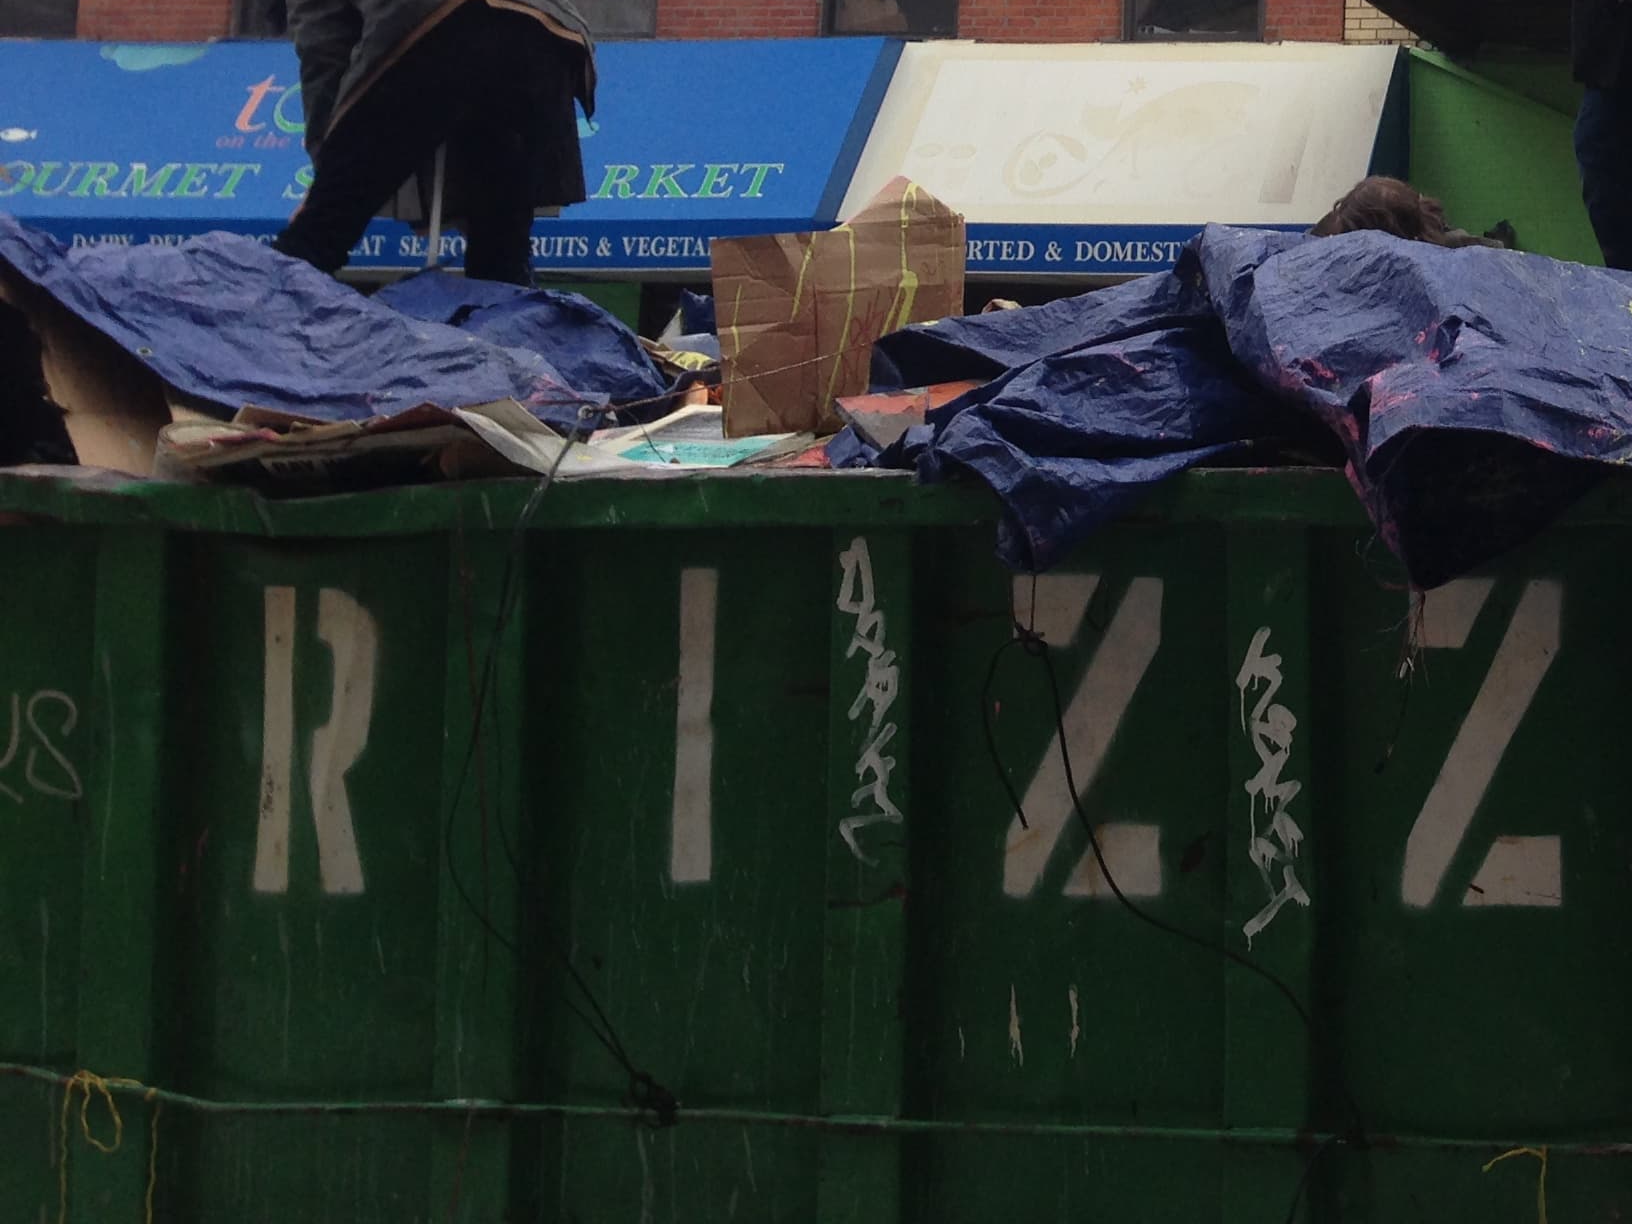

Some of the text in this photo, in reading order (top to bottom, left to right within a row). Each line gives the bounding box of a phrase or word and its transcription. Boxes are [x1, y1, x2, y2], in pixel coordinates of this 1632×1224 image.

[215, 136, 244, 149] on
[253, 131, 290, 149] the
[589, 162, 785, 200] RKET
[530, 235, 589, 257] RUITS
[595, 235, 613, 257] &
[966, 239, 1184, 264] RTED & DOMEST
